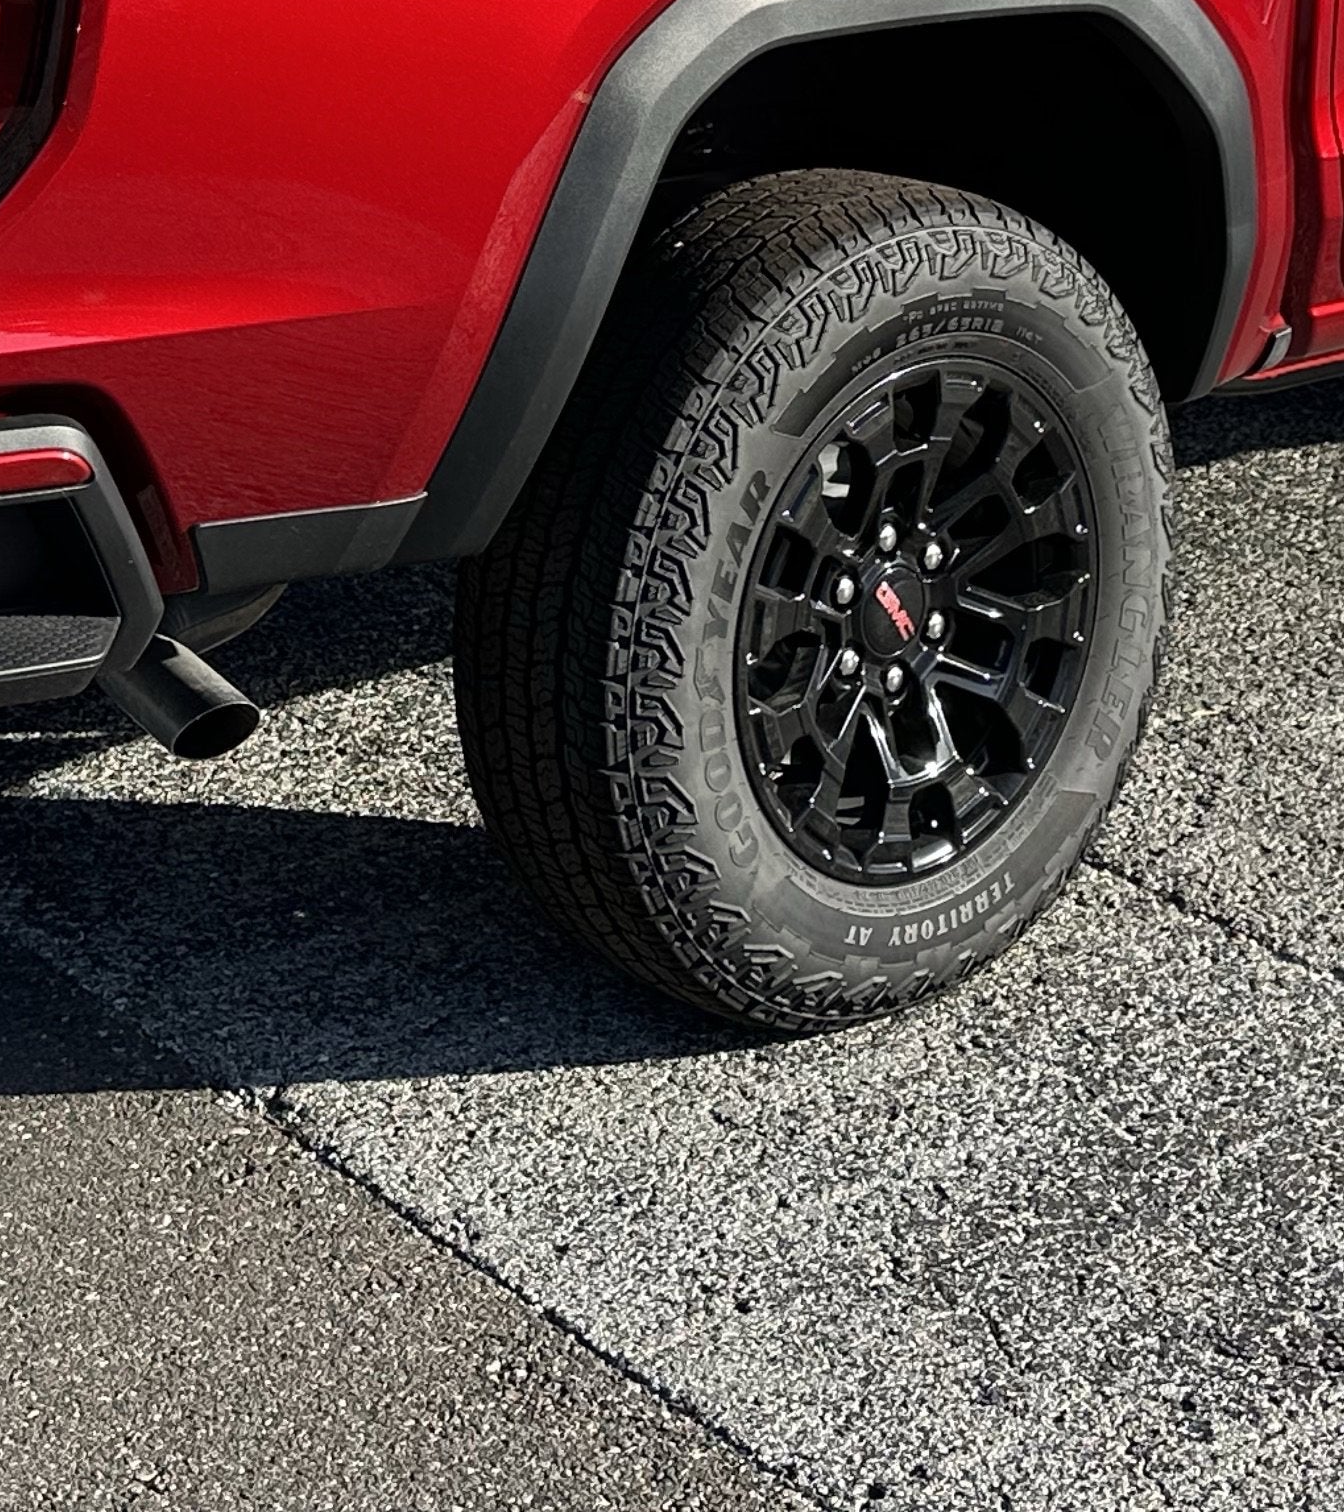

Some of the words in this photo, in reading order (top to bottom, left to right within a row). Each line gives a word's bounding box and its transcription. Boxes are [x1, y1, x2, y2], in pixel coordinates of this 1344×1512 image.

[875, 580, 916, 642] GMC
[1084, 404, 1154, 763] WRANGLER
[843, 924, 873, 947] AT
[887, 871, 1016, 947] TERRITORY
